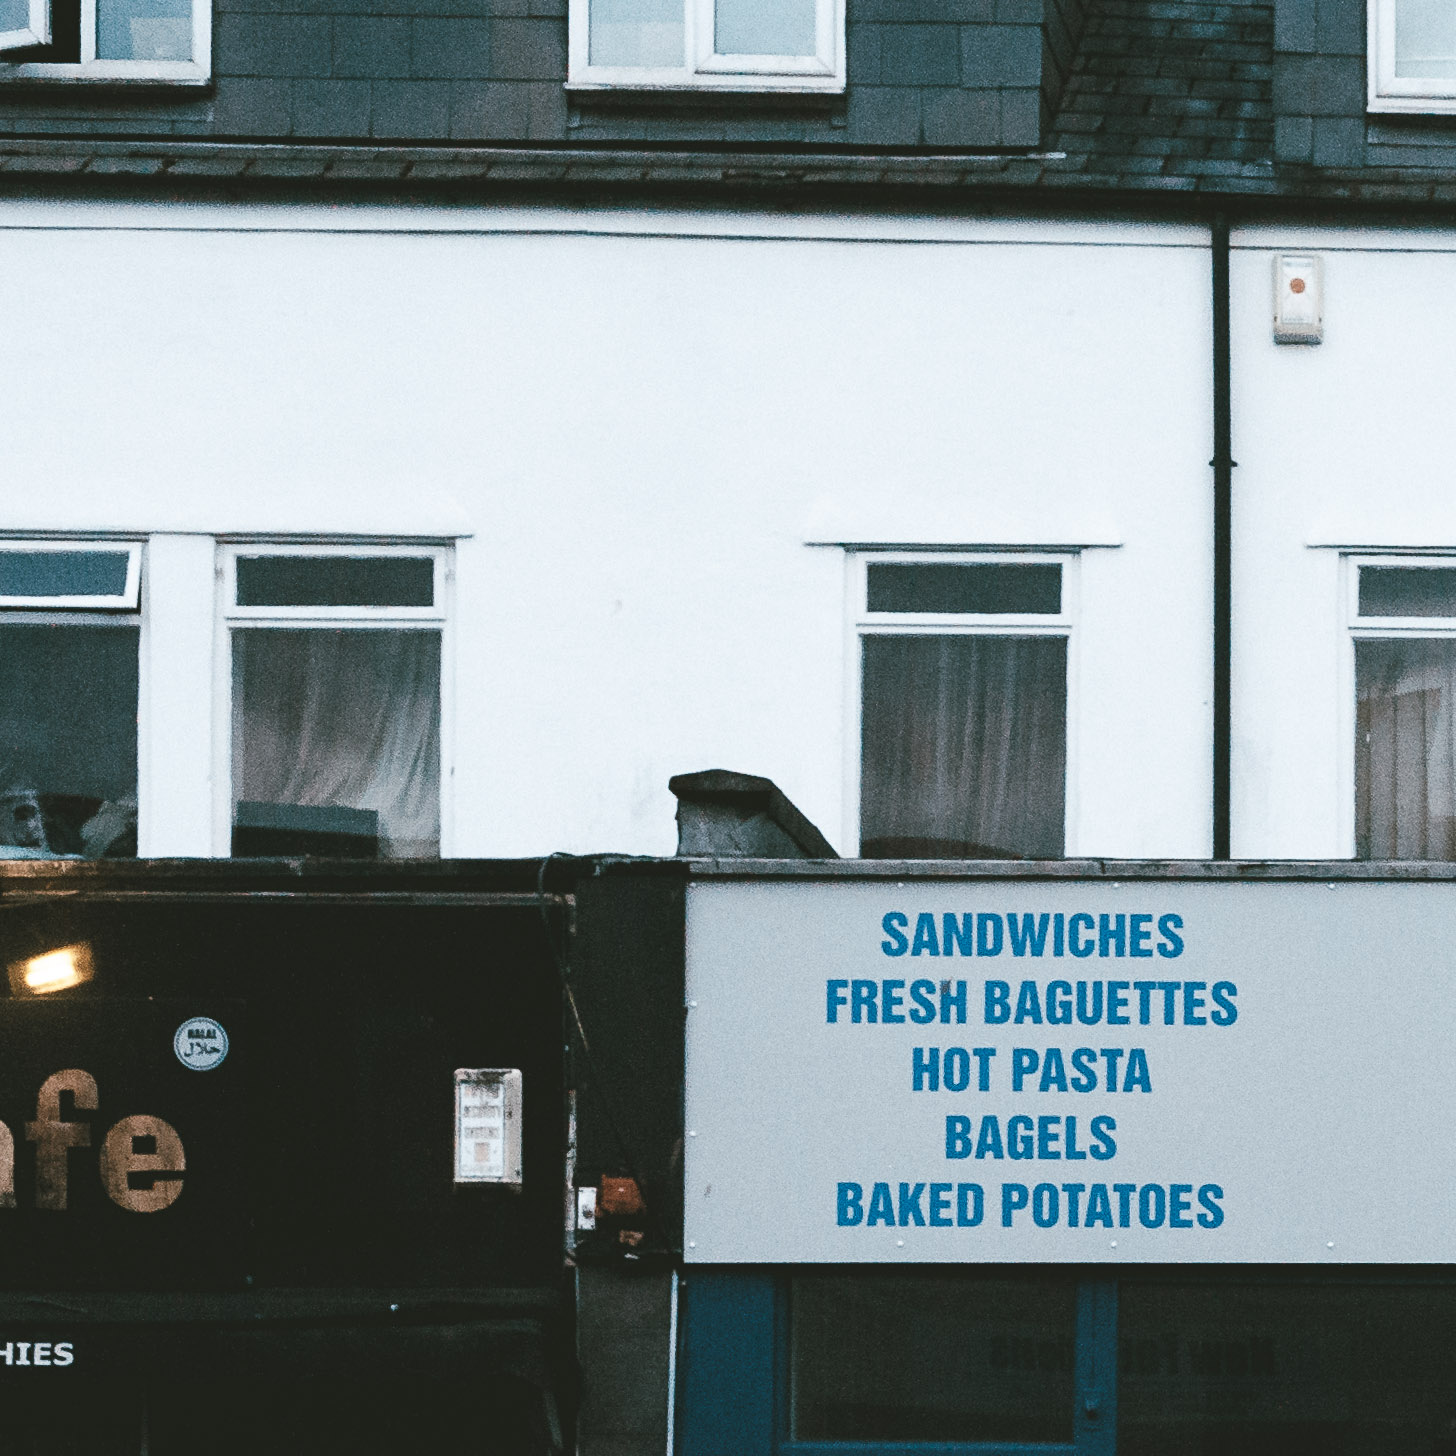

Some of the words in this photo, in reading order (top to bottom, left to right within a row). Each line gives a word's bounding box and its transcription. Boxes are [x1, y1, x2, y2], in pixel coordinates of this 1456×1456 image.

[881, 911, 1185, 958] SANDWICHES
[826, 978, 968, 1025] FRESH
[984, 980, 1239, 1027] BAGUETTES
[912, 1047, 997, 1092] HOT
[1011, 1047, 1153, 1094] PASTA
[0, 1068, 187, 1213] fe
[945, 1114, 1117, 1161] BAGELS
[836, 1181, 985, 1228] BAKED
[1001, 1182, 1225, 1229] POTATOES
[0, 1342, 75, 1366] HIES
